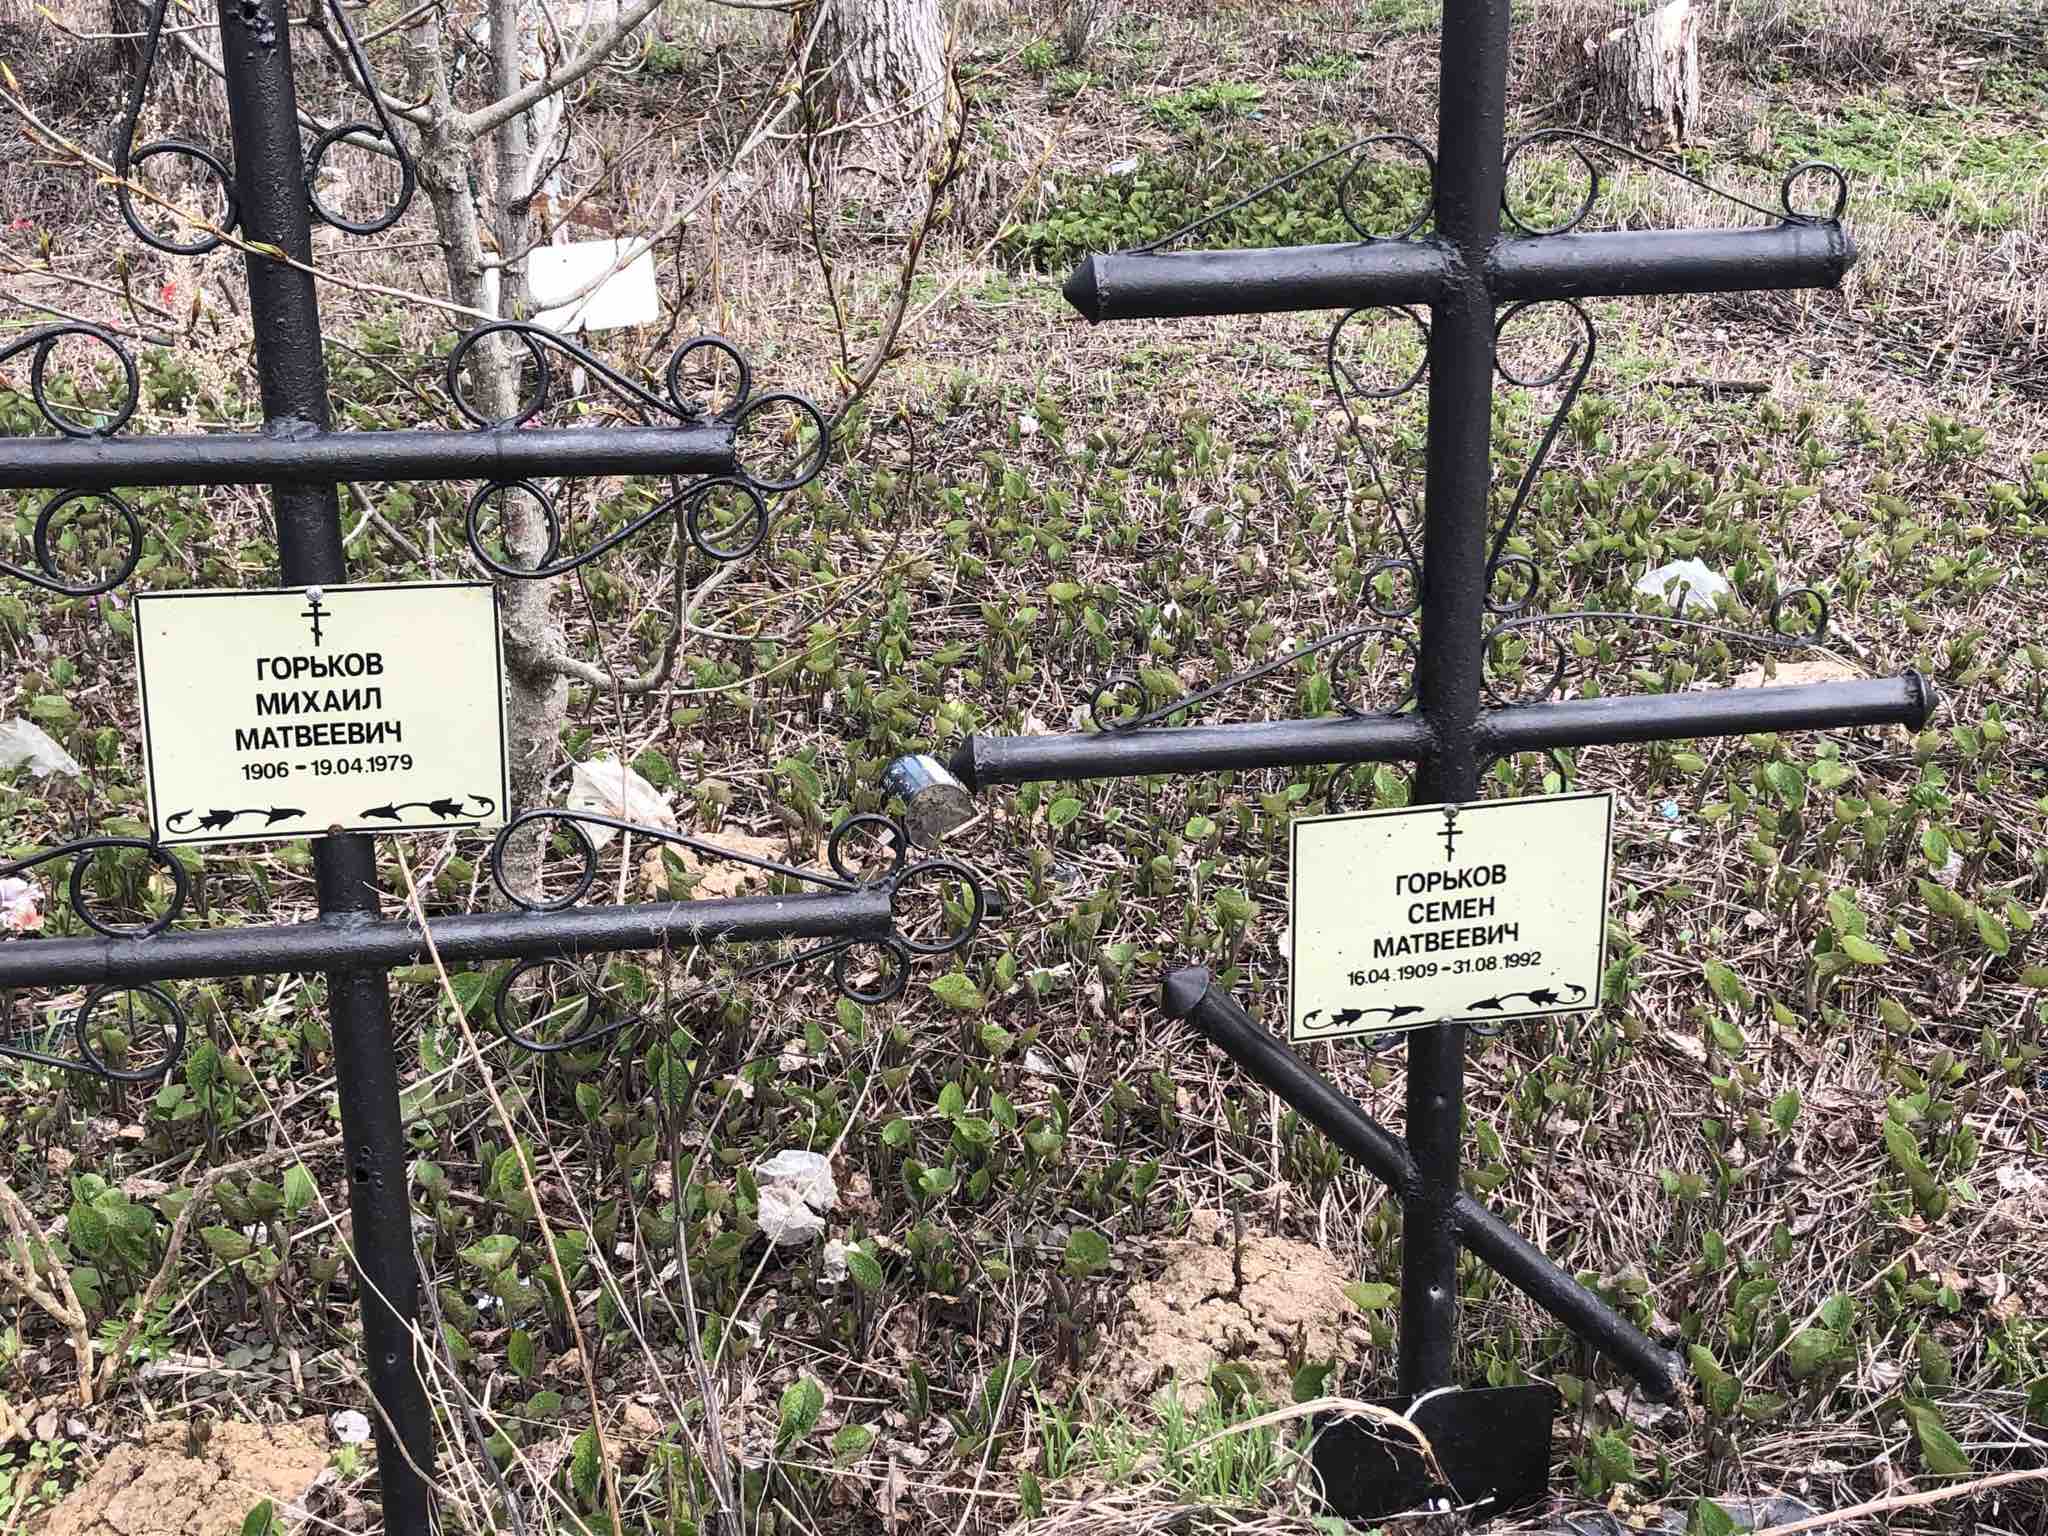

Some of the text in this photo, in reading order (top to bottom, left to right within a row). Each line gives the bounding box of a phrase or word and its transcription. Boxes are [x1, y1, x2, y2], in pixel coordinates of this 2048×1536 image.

[256, 652, 384, 681] ГОРЬКОВ
[255, 687, 382, 716] МИХАИЛ
[235, 720, 402, 752] МАТВЕЕВИЧ
[241, 761, 289, 781] 1906
[310, 753, 413, 777] 19.04.1979
[1396, 863, 1507, 896] ГОРЬКОВ
[1407, 895, 1495, 925] СЕМЕН
[1373, 922, 1519, 959] МАТВЕЕВИЧ
